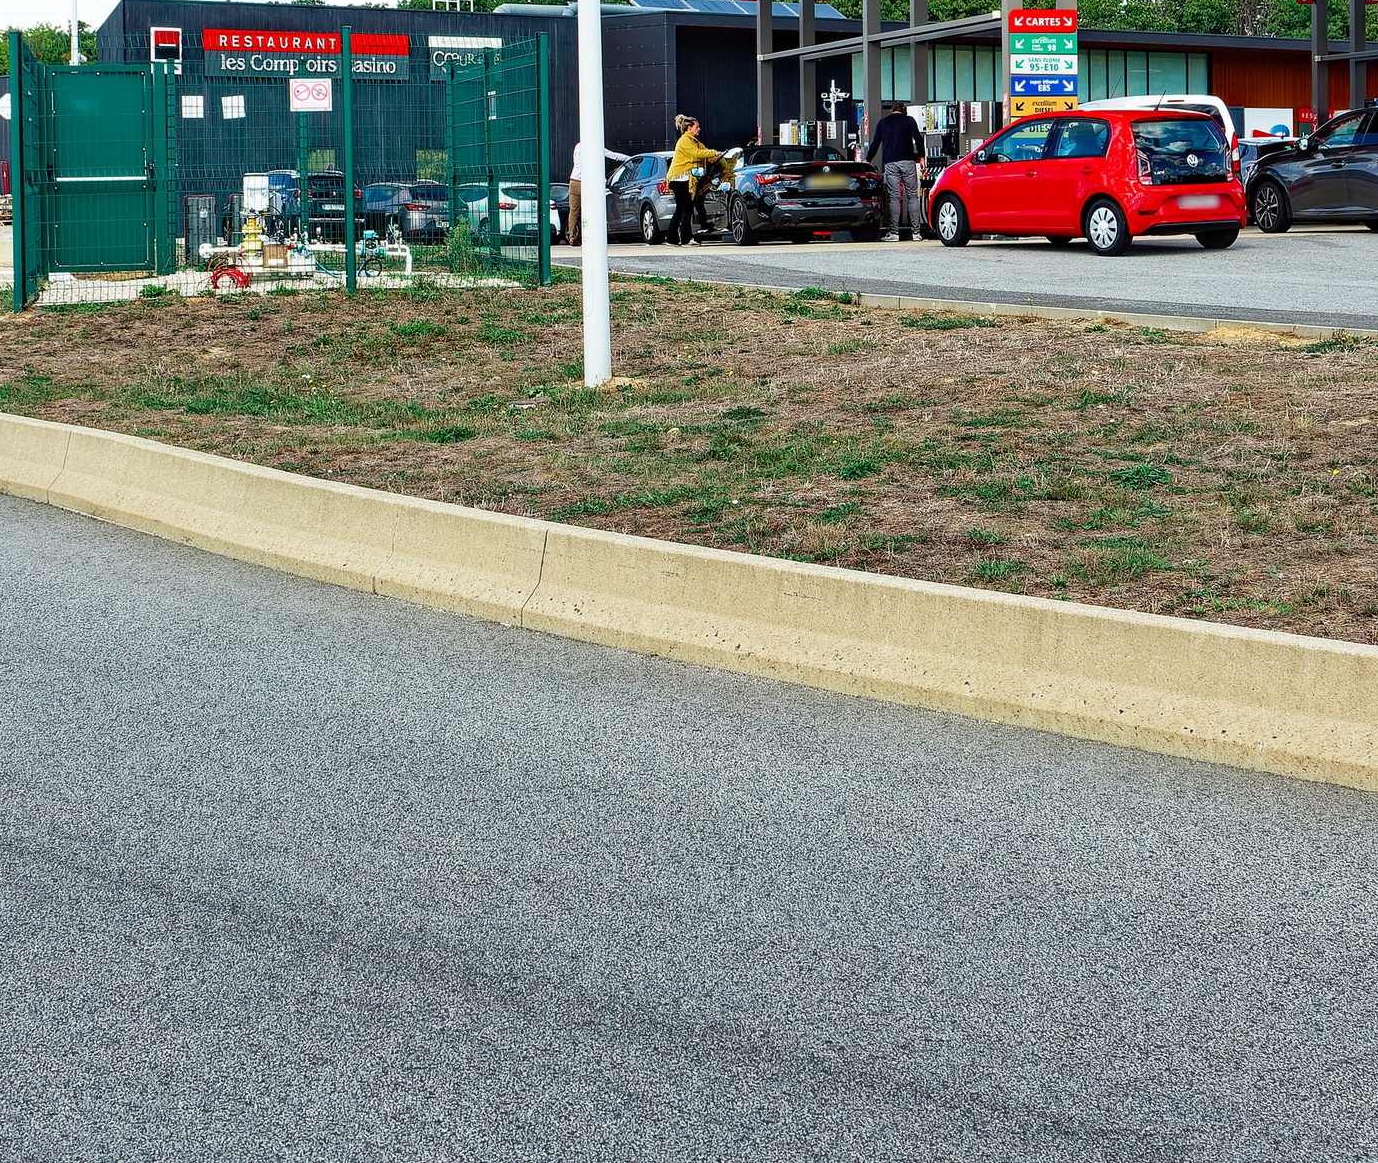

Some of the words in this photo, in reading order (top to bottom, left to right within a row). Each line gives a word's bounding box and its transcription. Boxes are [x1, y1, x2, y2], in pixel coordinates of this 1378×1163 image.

[1025, 17, 1061, 27] CARTES
[218, 34, 337, 51] RESTAURANT
[1047, 44, 1057, 52] 98
[220, 54, 246, 71] les
[350, 57, 397, 74] asino
[1029, 125, 1050, 133] DIES
